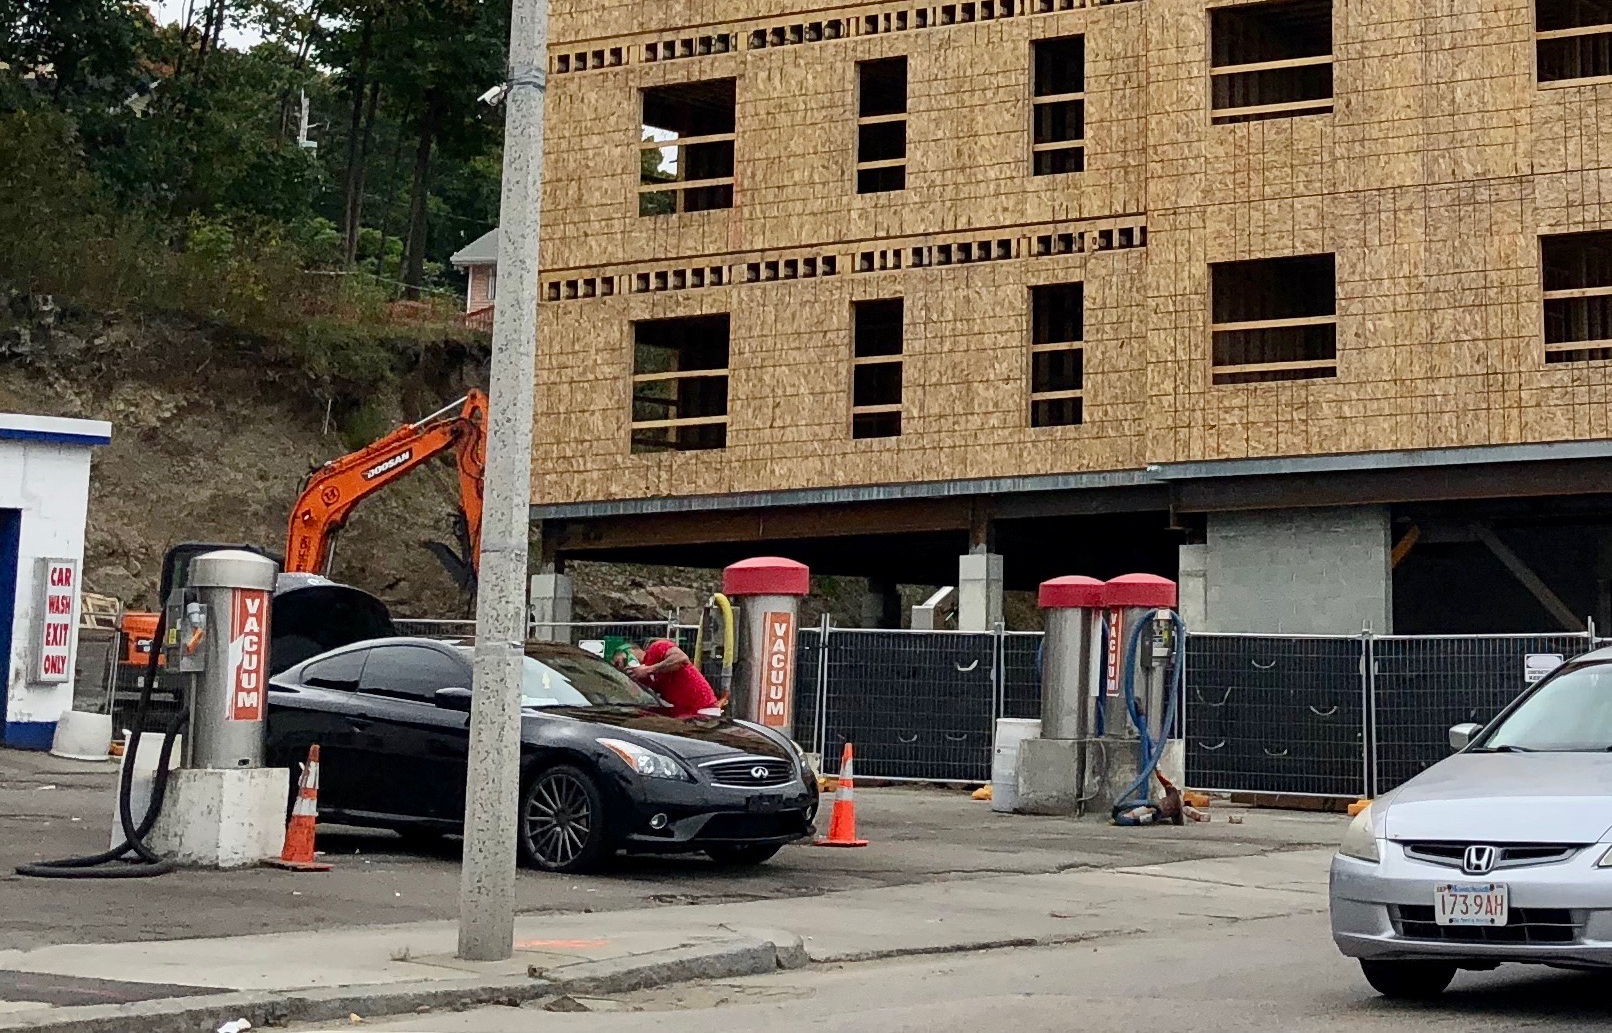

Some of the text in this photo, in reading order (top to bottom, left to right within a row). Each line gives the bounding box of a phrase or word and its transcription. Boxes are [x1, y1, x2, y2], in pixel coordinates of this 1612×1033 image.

[367, 451, 410, 479] DOOSAN
[50, 566, 72, 587] CAR
[48, 594, 71, 615] WASH
[45, 622, 69, 647] EXIT
[43, 654, 67, 675] ONLY
[237, 598, 261, 708] VACUUM
[1106, 612, 1118, 691] VACUUM
[766, 622, 788, 716] VACUUM
